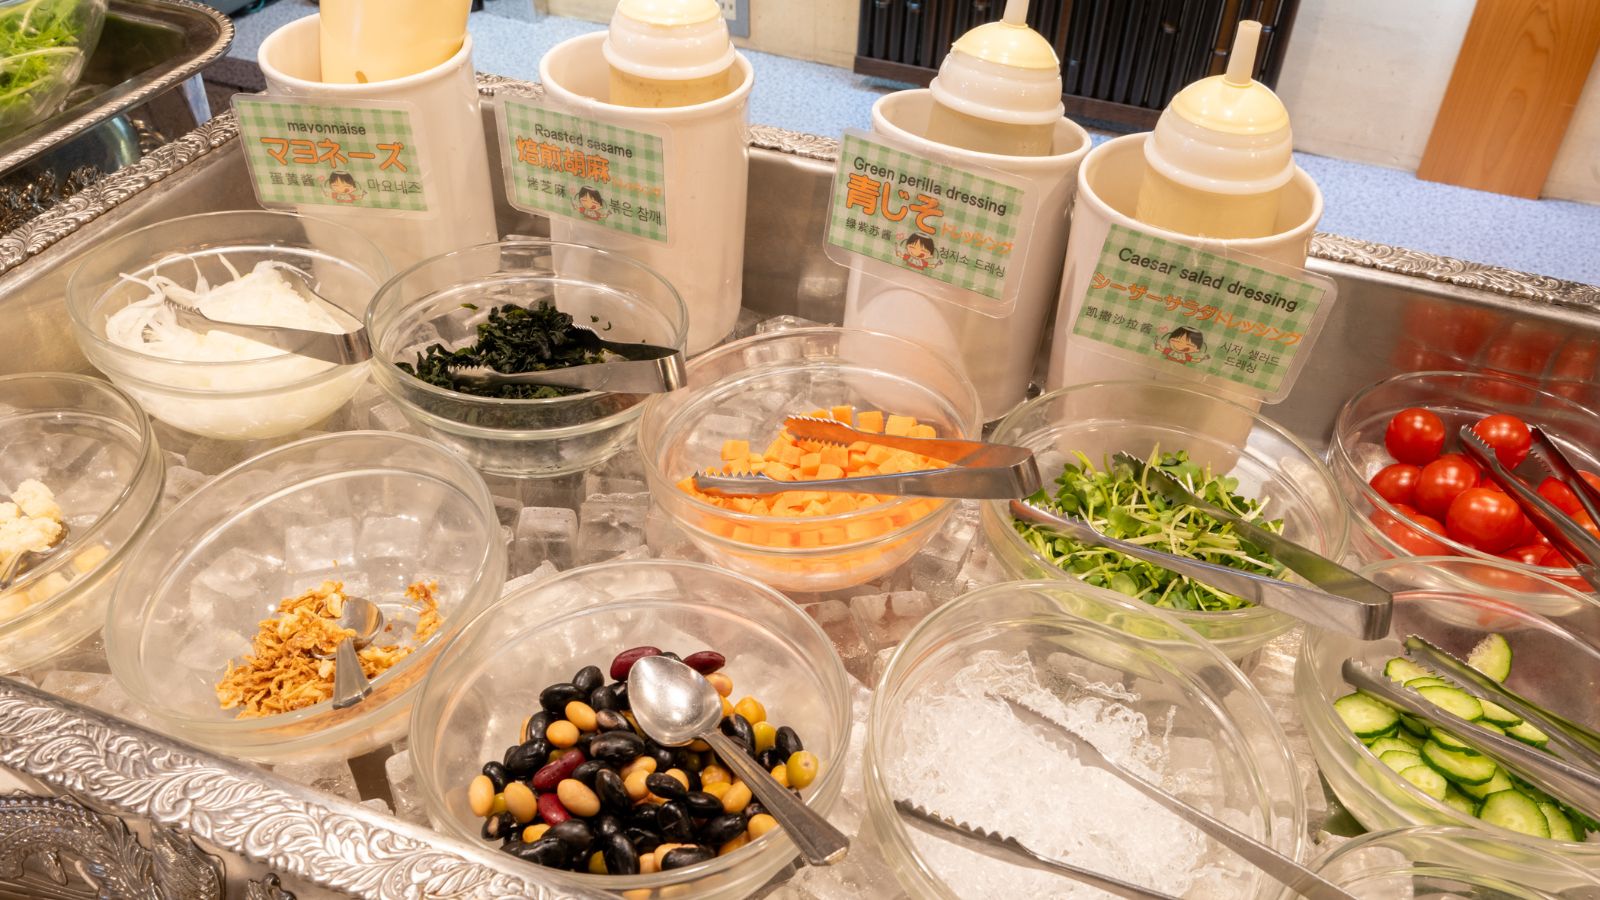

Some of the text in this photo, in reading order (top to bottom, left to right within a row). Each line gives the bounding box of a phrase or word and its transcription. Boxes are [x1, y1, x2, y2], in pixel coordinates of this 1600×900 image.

[287, 121, 366, 136] mayonnaise
[534, 123, 633, 159] Roasted sesame
[260, 137, 408, 173] マヨネーズ
[516, 135, 612, 184] 焙煎胡麻
[367, 178, 423, 195] 마요네즈
[846, 172, 944, 235] 青じそ
[853, 156, 1007, 217] Green perilla dressing
[609, 198, 662, 226] 볶은 참깨
[939, 247, 969, 265] 청지소
[1118, 247, 1299, 313] Caesar salad dressing
[1090, 271, 1304, 347] シーザーサラダドレッシング
[1220, 341, 1281, 367] 시저 샐러드
